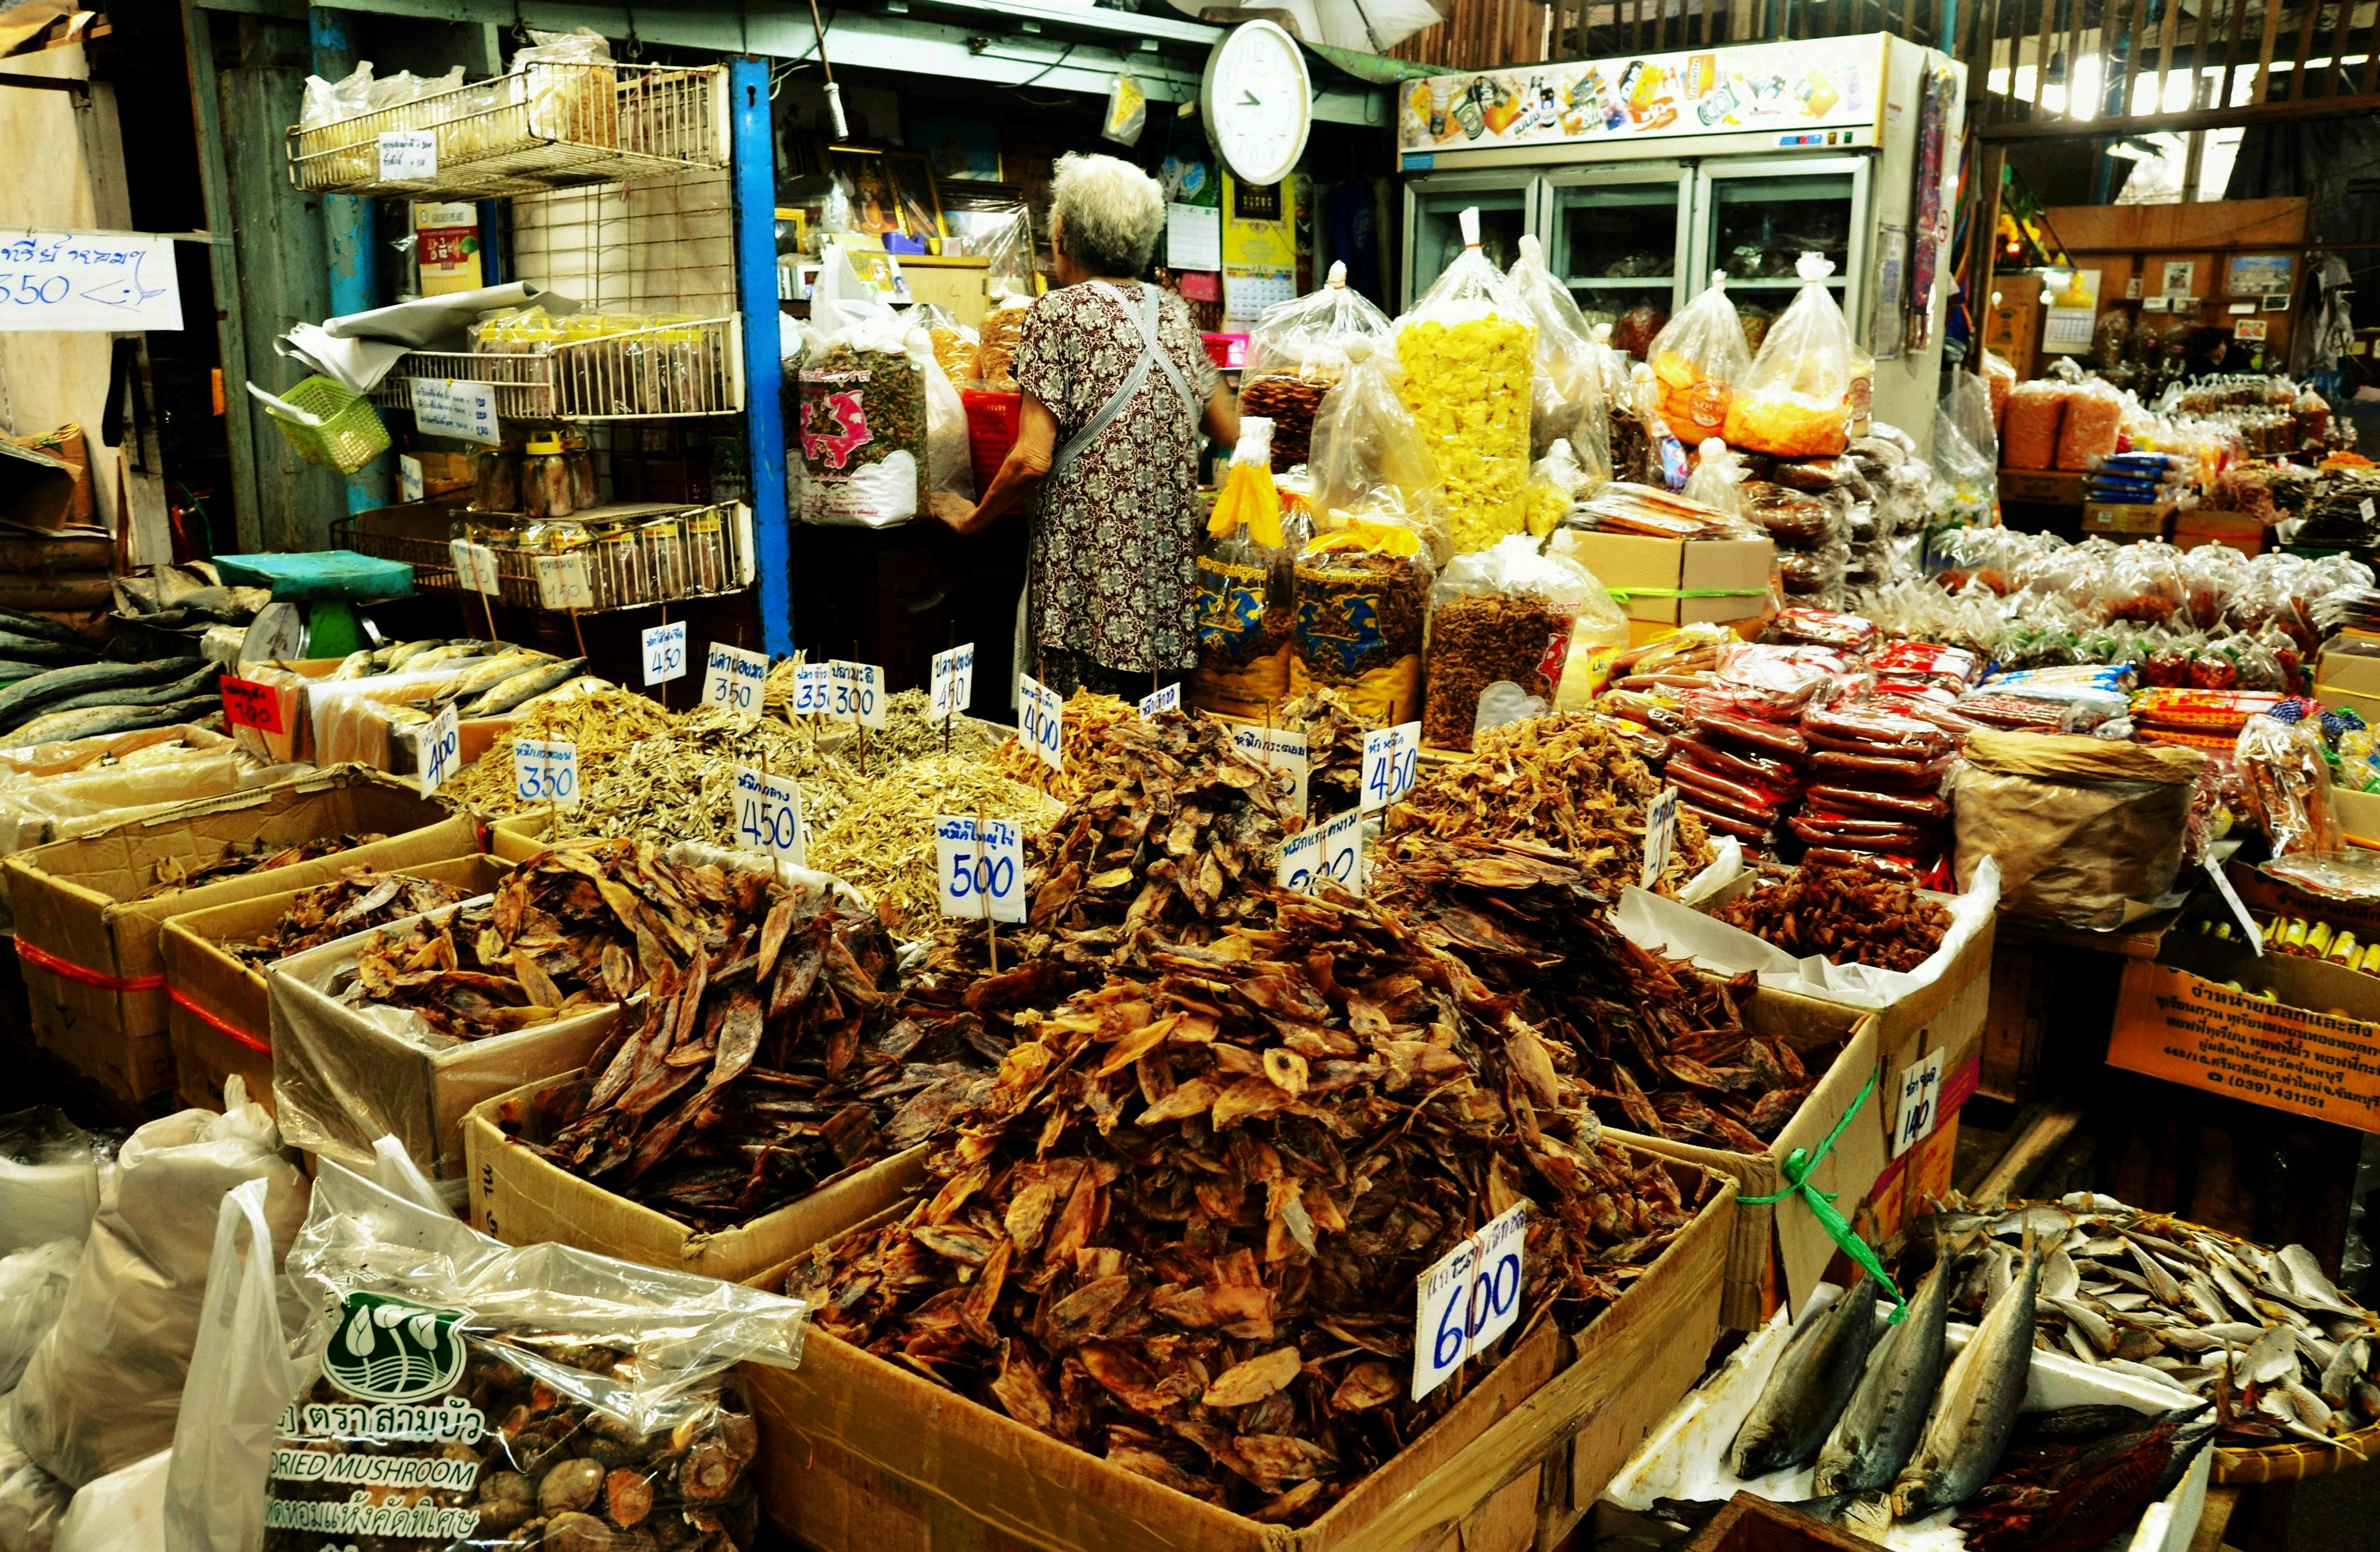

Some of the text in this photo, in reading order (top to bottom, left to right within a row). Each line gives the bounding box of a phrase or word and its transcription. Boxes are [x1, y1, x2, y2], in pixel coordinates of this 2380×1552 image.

[652, 648, 681, 673] 450
[715, 678, 751, 707] 350
[797, 685, 830, 708] 35
[836, 686, 874, 715] 300
[937, 677, 964, 709] 450
[1025, 704, 1058, 751] 400
[428, 731, 455, 785] 400
[1369, 747, 1416, 800] 450
[520, 766, 573, 797] 350
[742, 799, 795, 849] 450
[950, 853, 1014, 898] 500
[2229, 1079, 2325, 1109] (039) 431151
[1902, 1099, 1929, 1144] 140
[1434, 1254, 1520, 1369] 600
[271, 1452, 475, 1487] DRIED MUSHROOM
